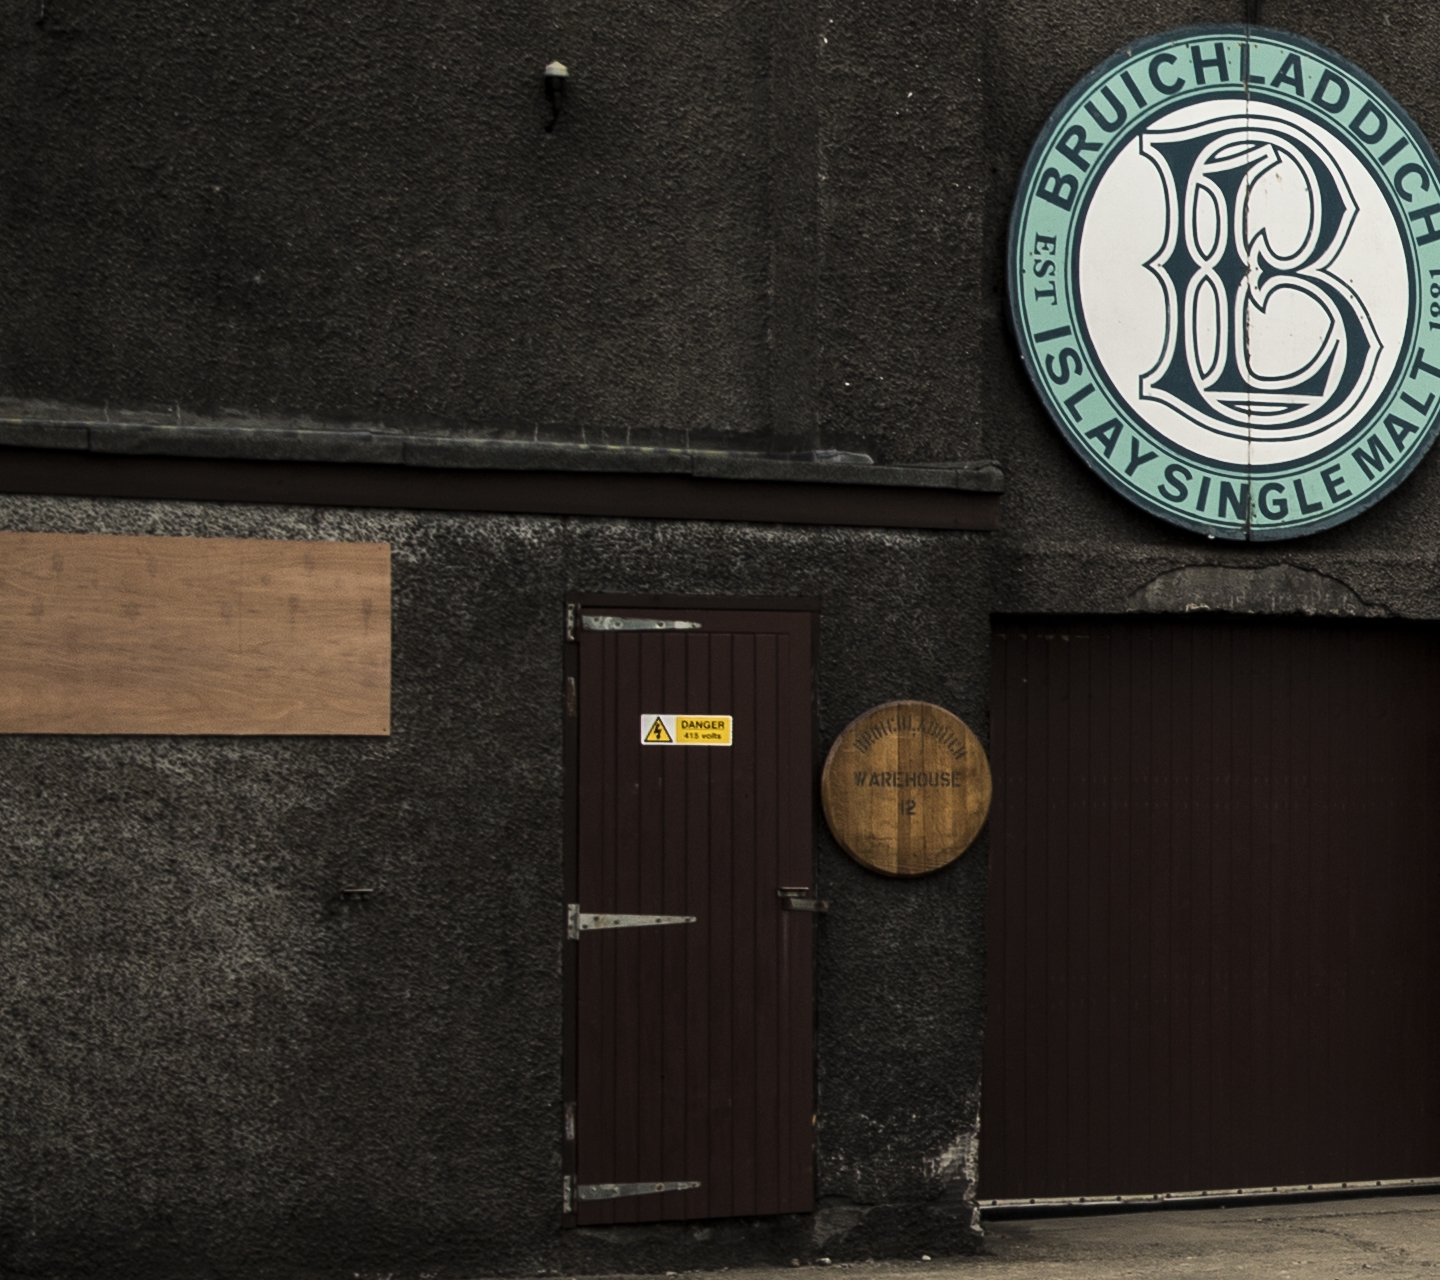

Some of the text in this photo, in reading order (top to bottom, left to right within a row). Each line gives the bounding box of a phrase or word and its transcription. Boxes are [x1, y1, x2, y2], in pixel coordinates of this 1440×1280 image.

[1032, 233, 1058, 306] EST
[1033, 326, 1158, 477] ISLAY
[1156, 462, 1353, 521] SINGLE
[681, 720, 725, 730] DANGER
[702, 732, 722, 740] volts
[854, 771, 962, 788] WAREHOUSE
[899, 798, 917, 816] 12
